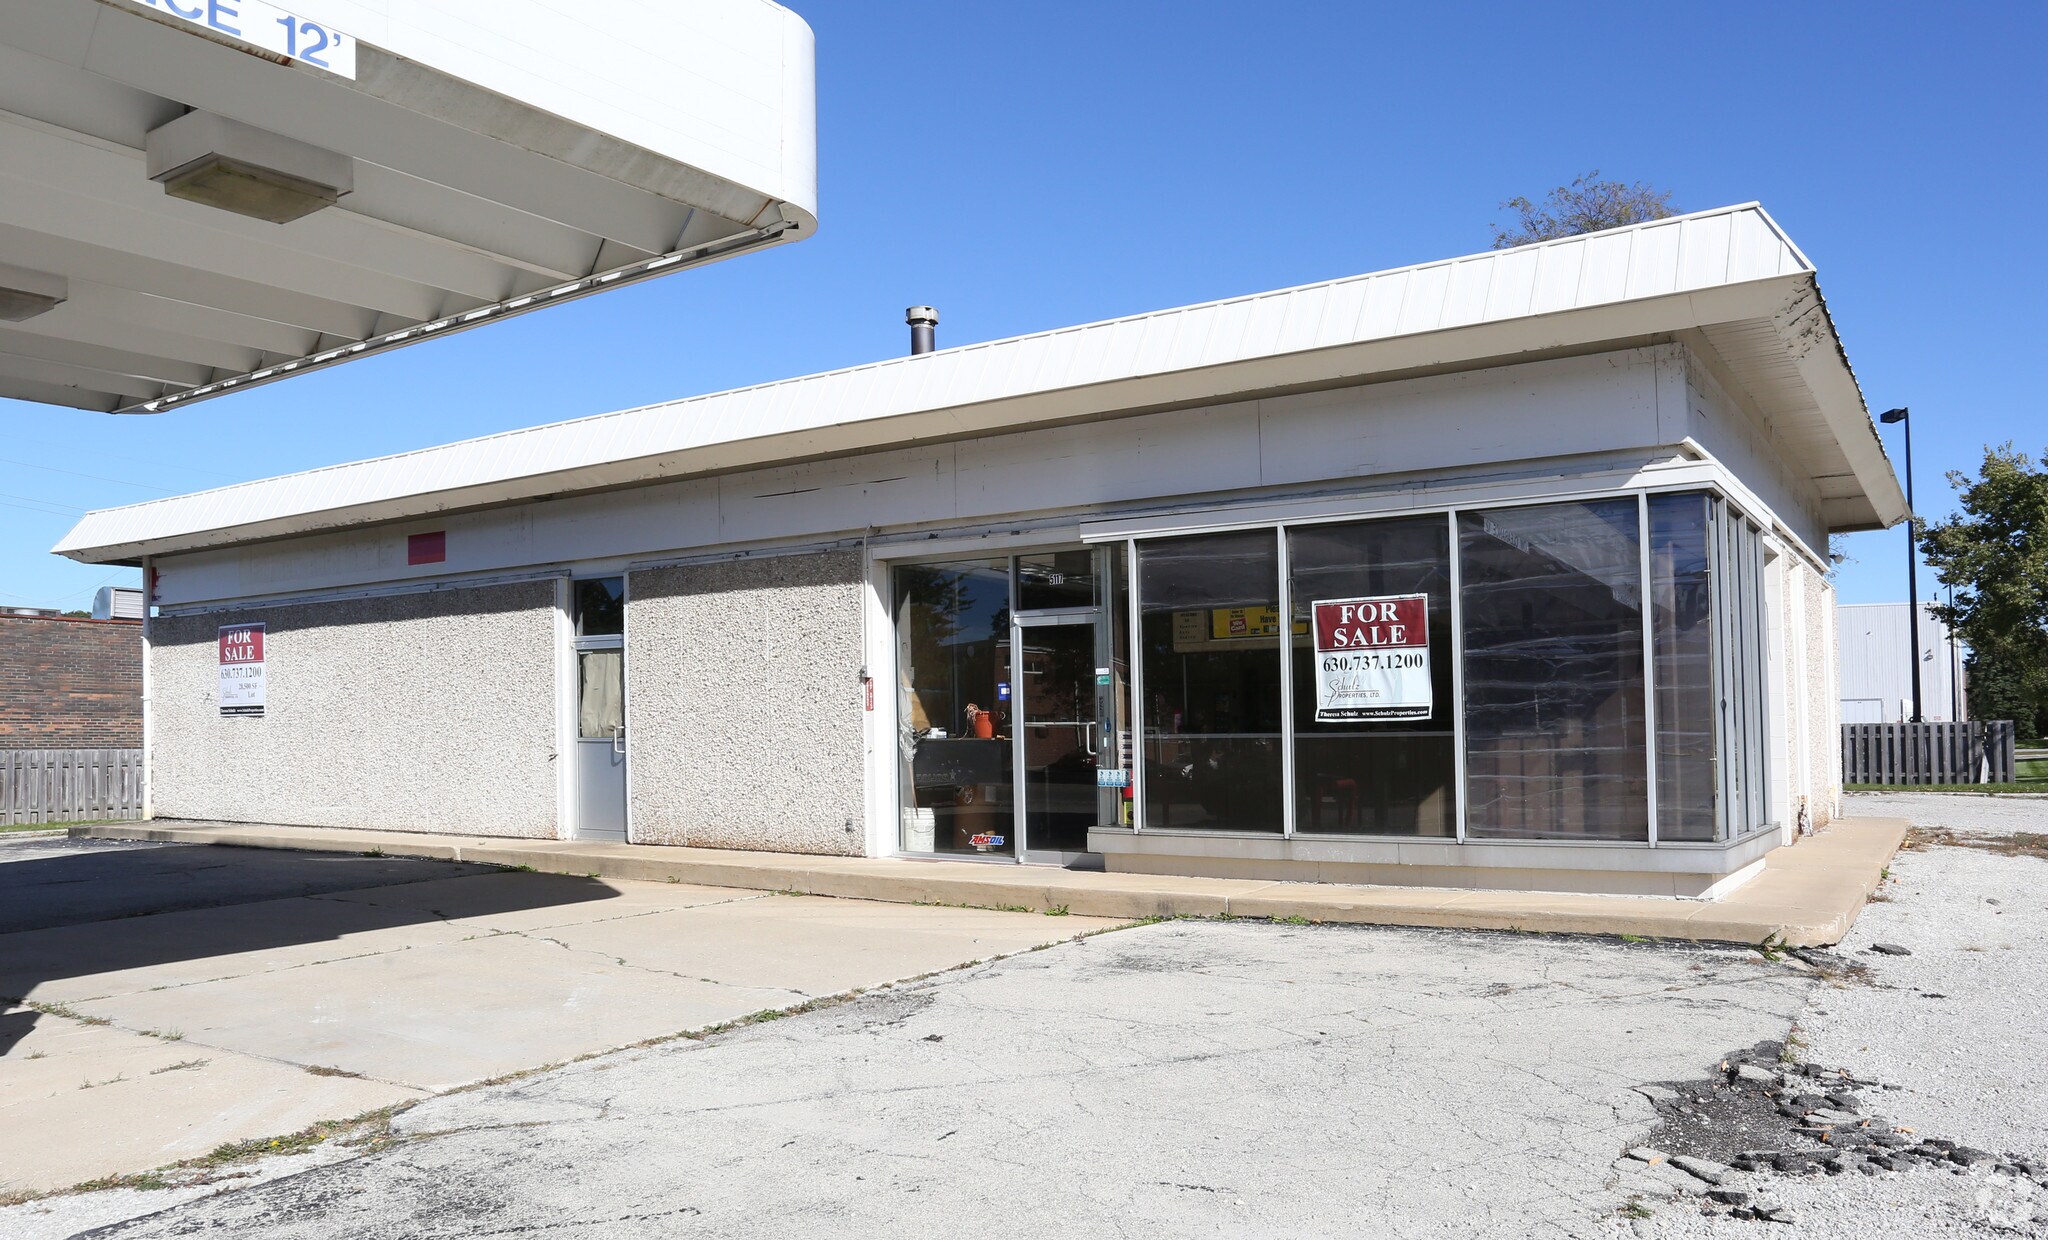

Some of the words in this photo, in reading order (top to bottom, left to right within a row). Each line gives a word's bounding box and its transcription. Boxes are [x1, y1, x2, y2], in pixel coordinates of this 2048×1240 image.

[1049, 573, 1063, 585] 5117
[1260, 615, 1277, 624] Have
[1340, 602, 1400, 624] FOR
[227, 630, 251, 644] FOR
[1333, 625, 1407, 647] SALE
[225, 645, 255, 661] SALE
[1323, 653, 1423, 672] 630.737.1200
[221, 666, 262, 679] 630.737.1200
[1326, 675, 1360, 696] Schulz
[1361, 708, 1428, 718] www.SchulzProperties.com
[971, 835, 1003, 845] AMSOIL
